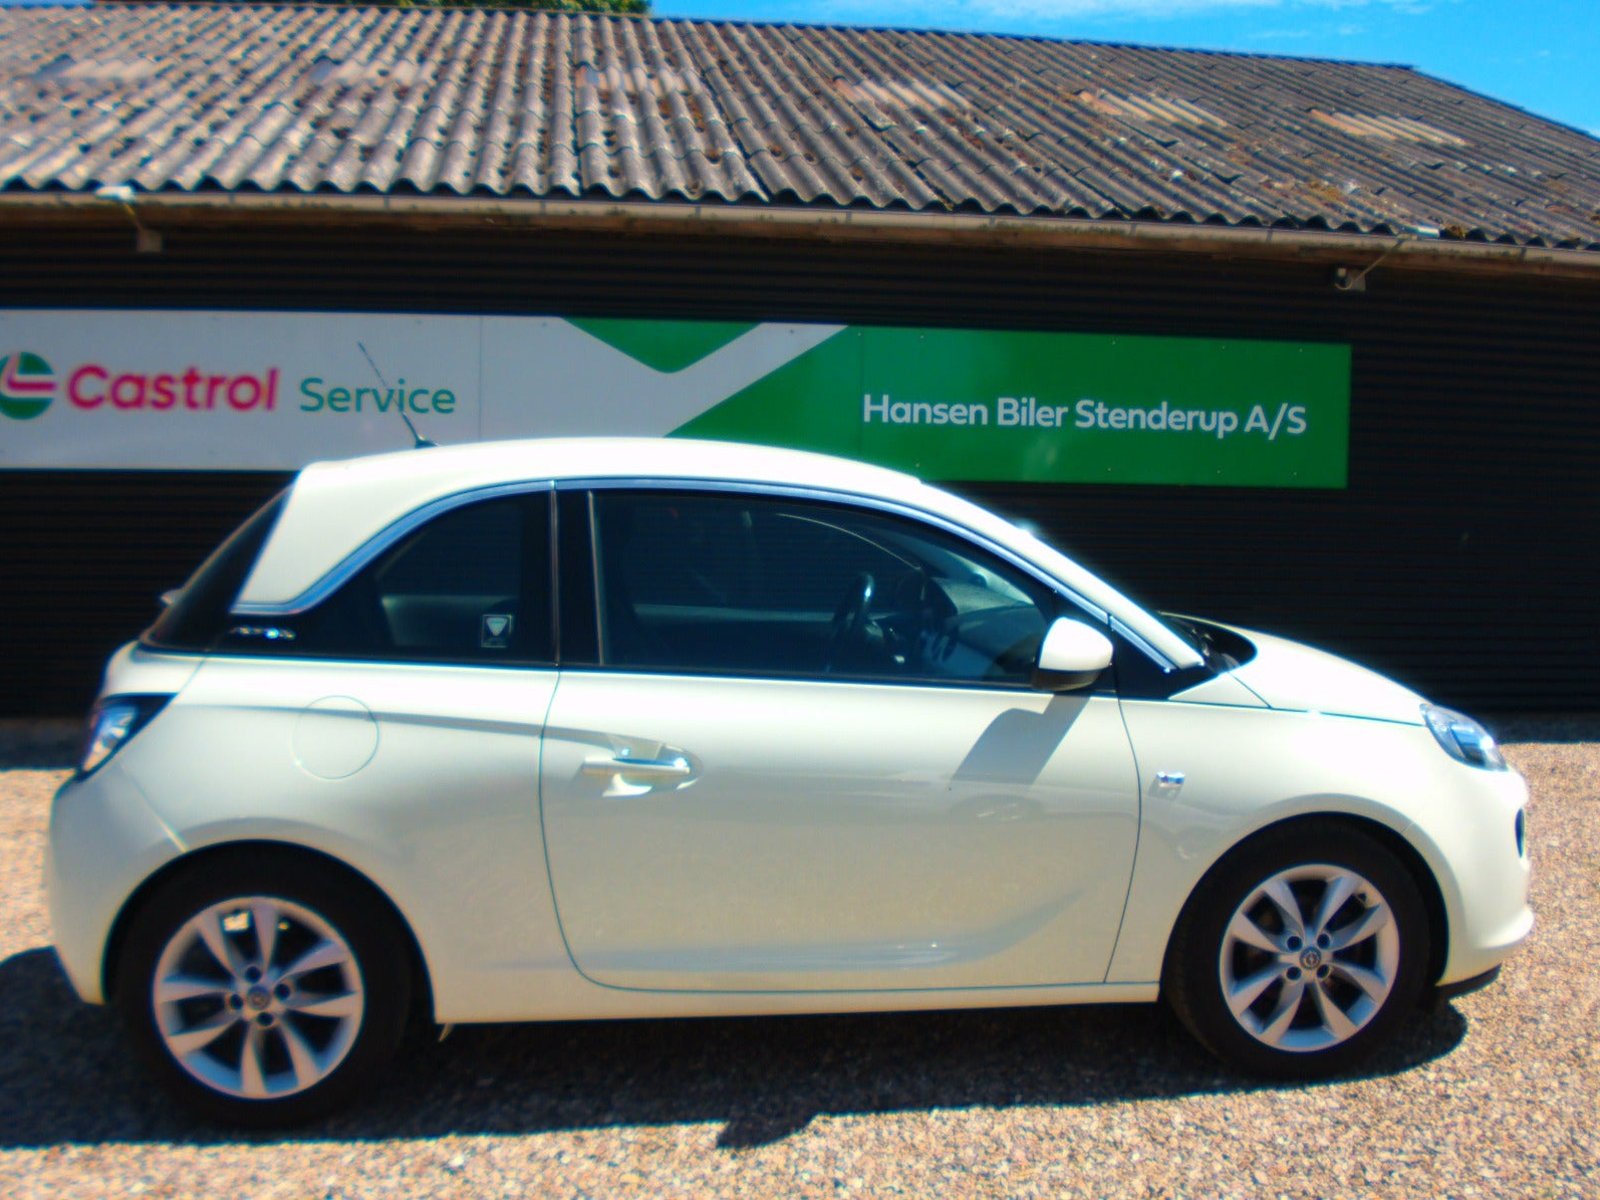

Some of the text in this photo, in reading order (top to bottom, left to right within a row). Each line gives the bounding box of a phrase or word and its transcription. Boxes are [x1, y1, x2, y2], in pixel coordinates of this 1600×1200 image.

[67, 364, 456, 414] Castrol Service
[863, 394, 1307, 440] Hansen Biler Stenderup A/S
